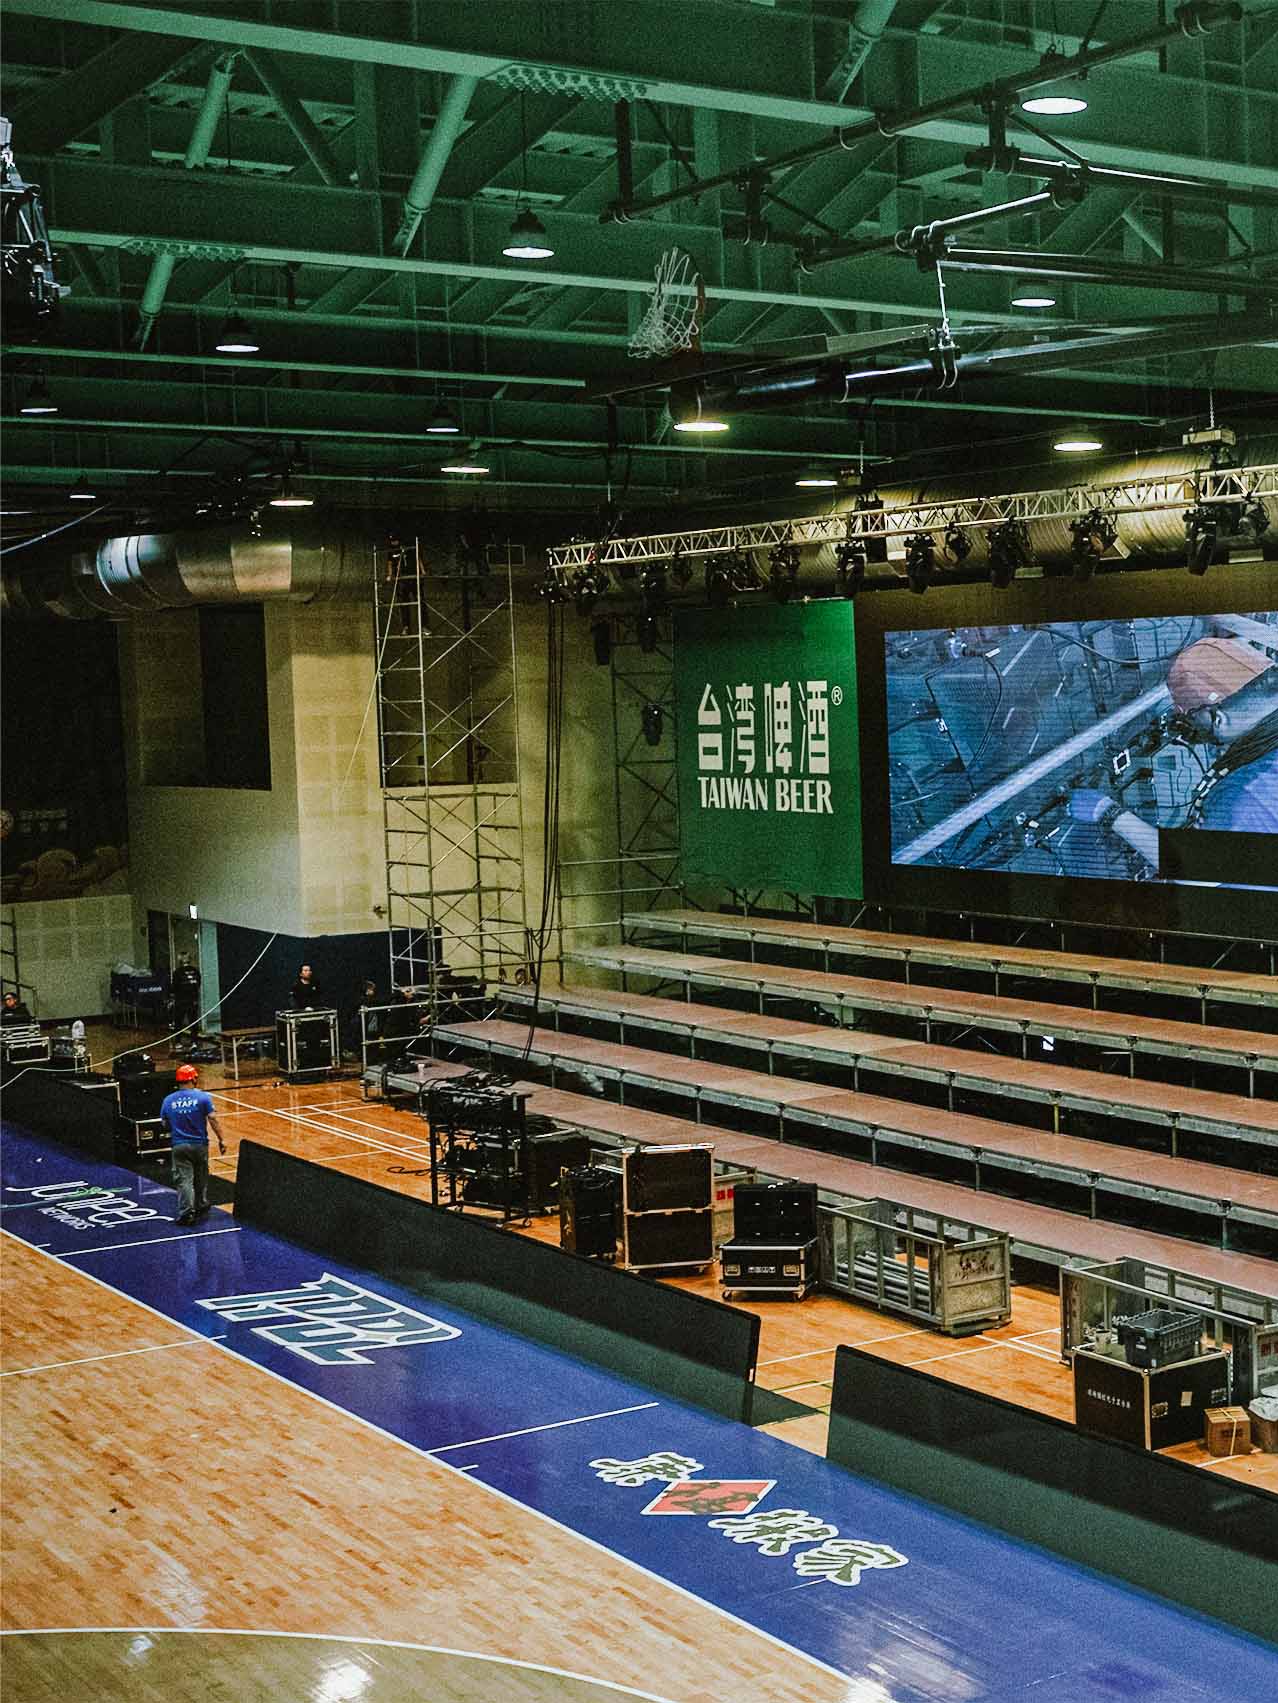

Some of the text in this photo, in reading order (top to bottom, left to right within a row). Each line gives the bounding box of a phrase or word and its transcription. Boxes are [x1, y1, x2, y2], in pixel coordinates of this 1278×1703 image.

[697, 777, 834, 814] TAIWAN BEER
[171, 1099, 198, 1109] STAFF
